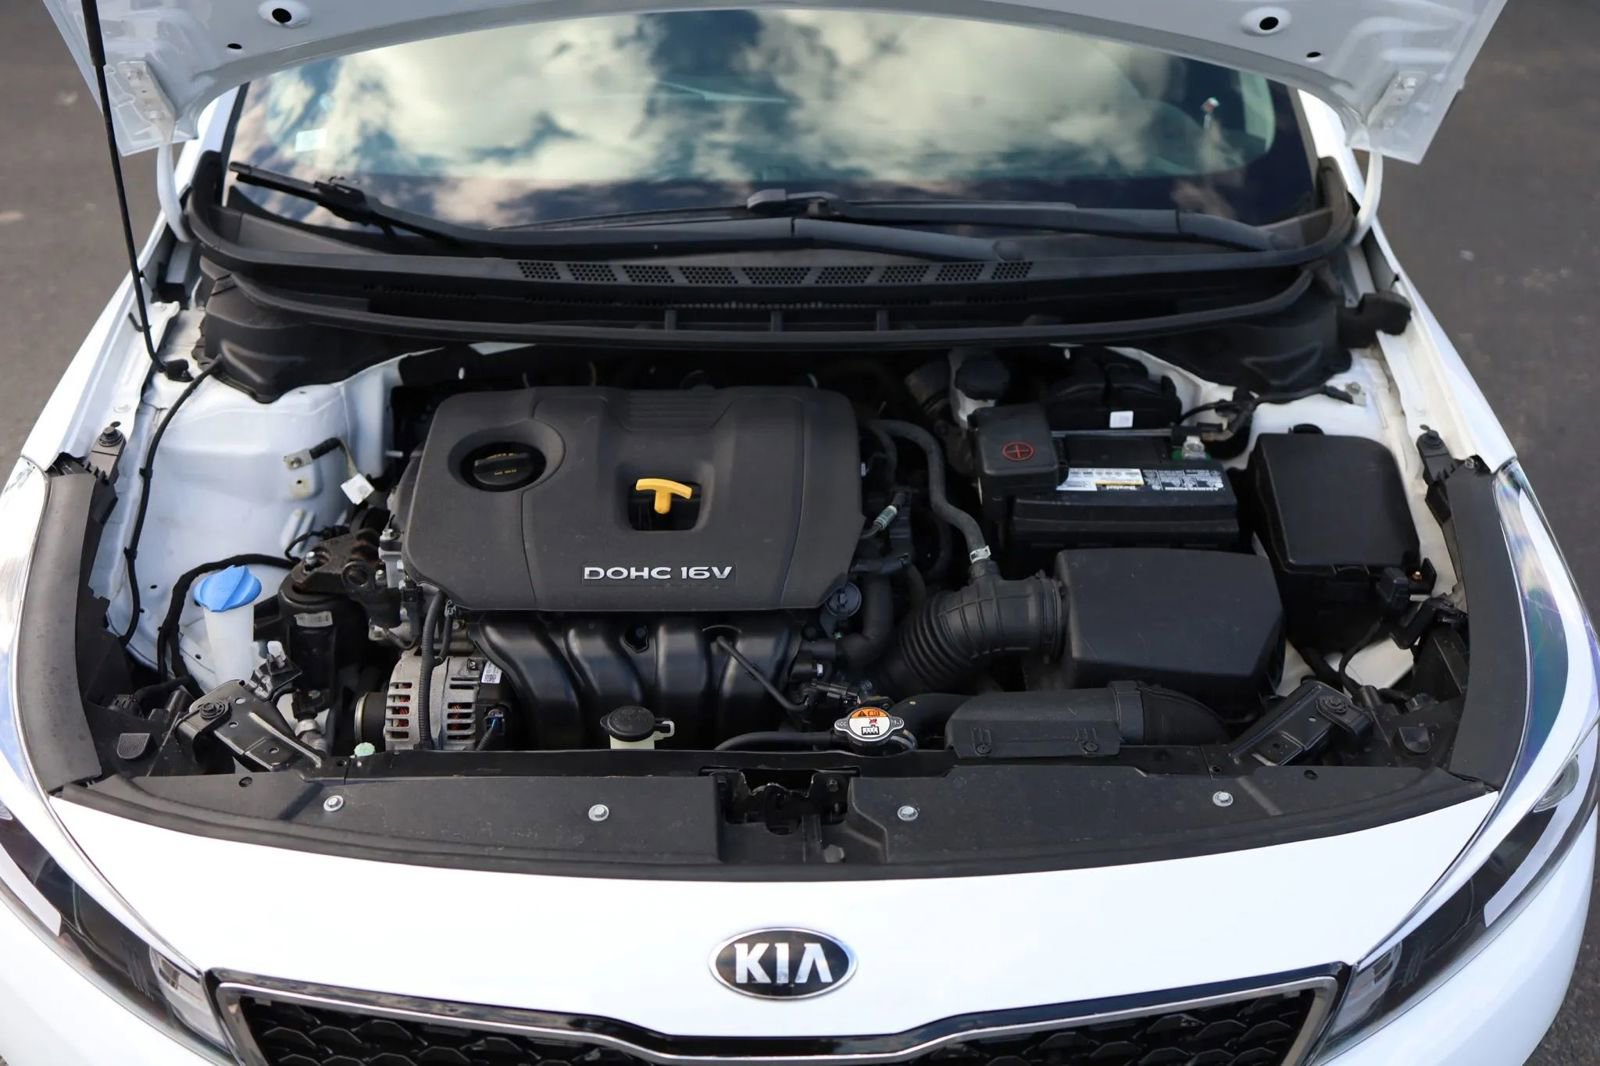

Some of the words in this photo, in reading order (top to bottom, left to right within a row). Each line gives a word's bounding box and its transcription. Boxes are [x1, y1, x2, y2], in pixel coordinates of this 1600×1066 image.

[583, 566, 672, 580] DOHC
[680, 566, 733, 580] 16V
[734, 943, 834, 984] KIA
